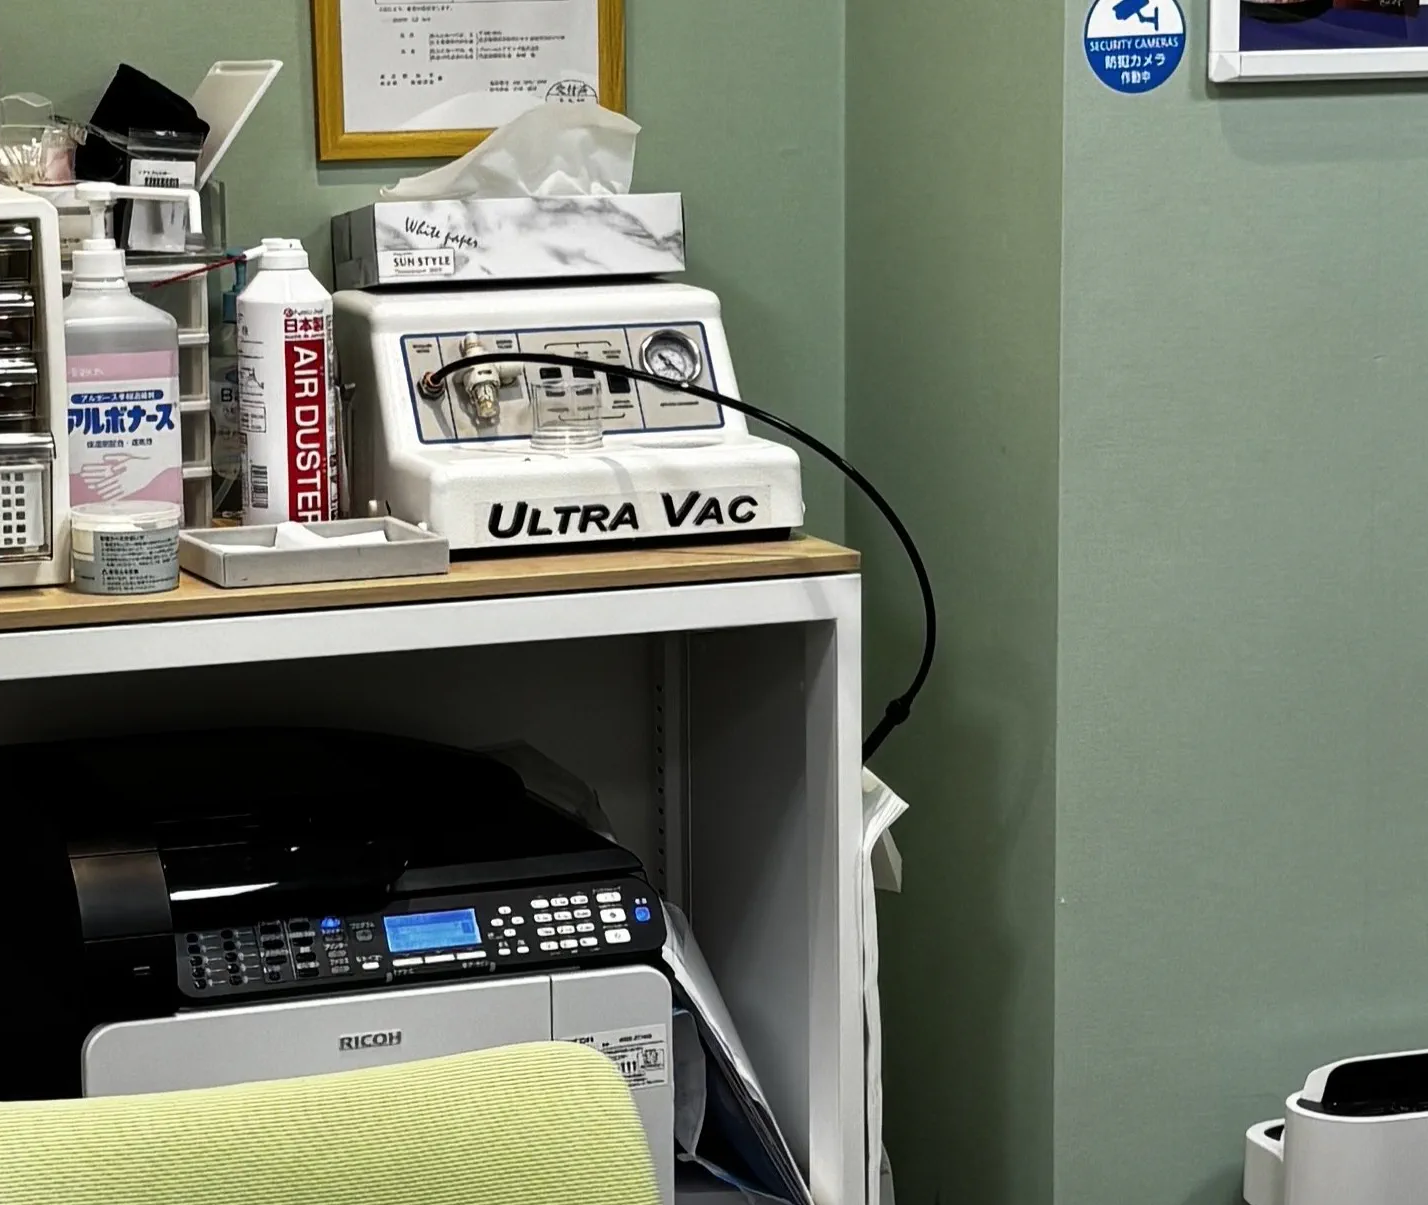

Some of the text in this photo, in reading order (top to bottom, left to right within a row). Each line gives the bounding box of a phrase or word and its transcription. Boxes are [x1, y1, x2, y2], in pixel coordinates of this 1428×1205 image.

[1089, 37, 1178, 51] SECURITY CAMERAS
[1105, 53, 1165, 69] 防犯カメラ
[405, 216, 440, 238] White
[393, 256, 450, 267] SUN STYLE
[284, 317, 324, 333] 日本製
[293, 346, 319, 398] AIR
[68, 403, 175, 435] アルボナース
[488, 491, 758, 538] ULTRA VAC
[339, 1031, 402, 1051] RICOH
